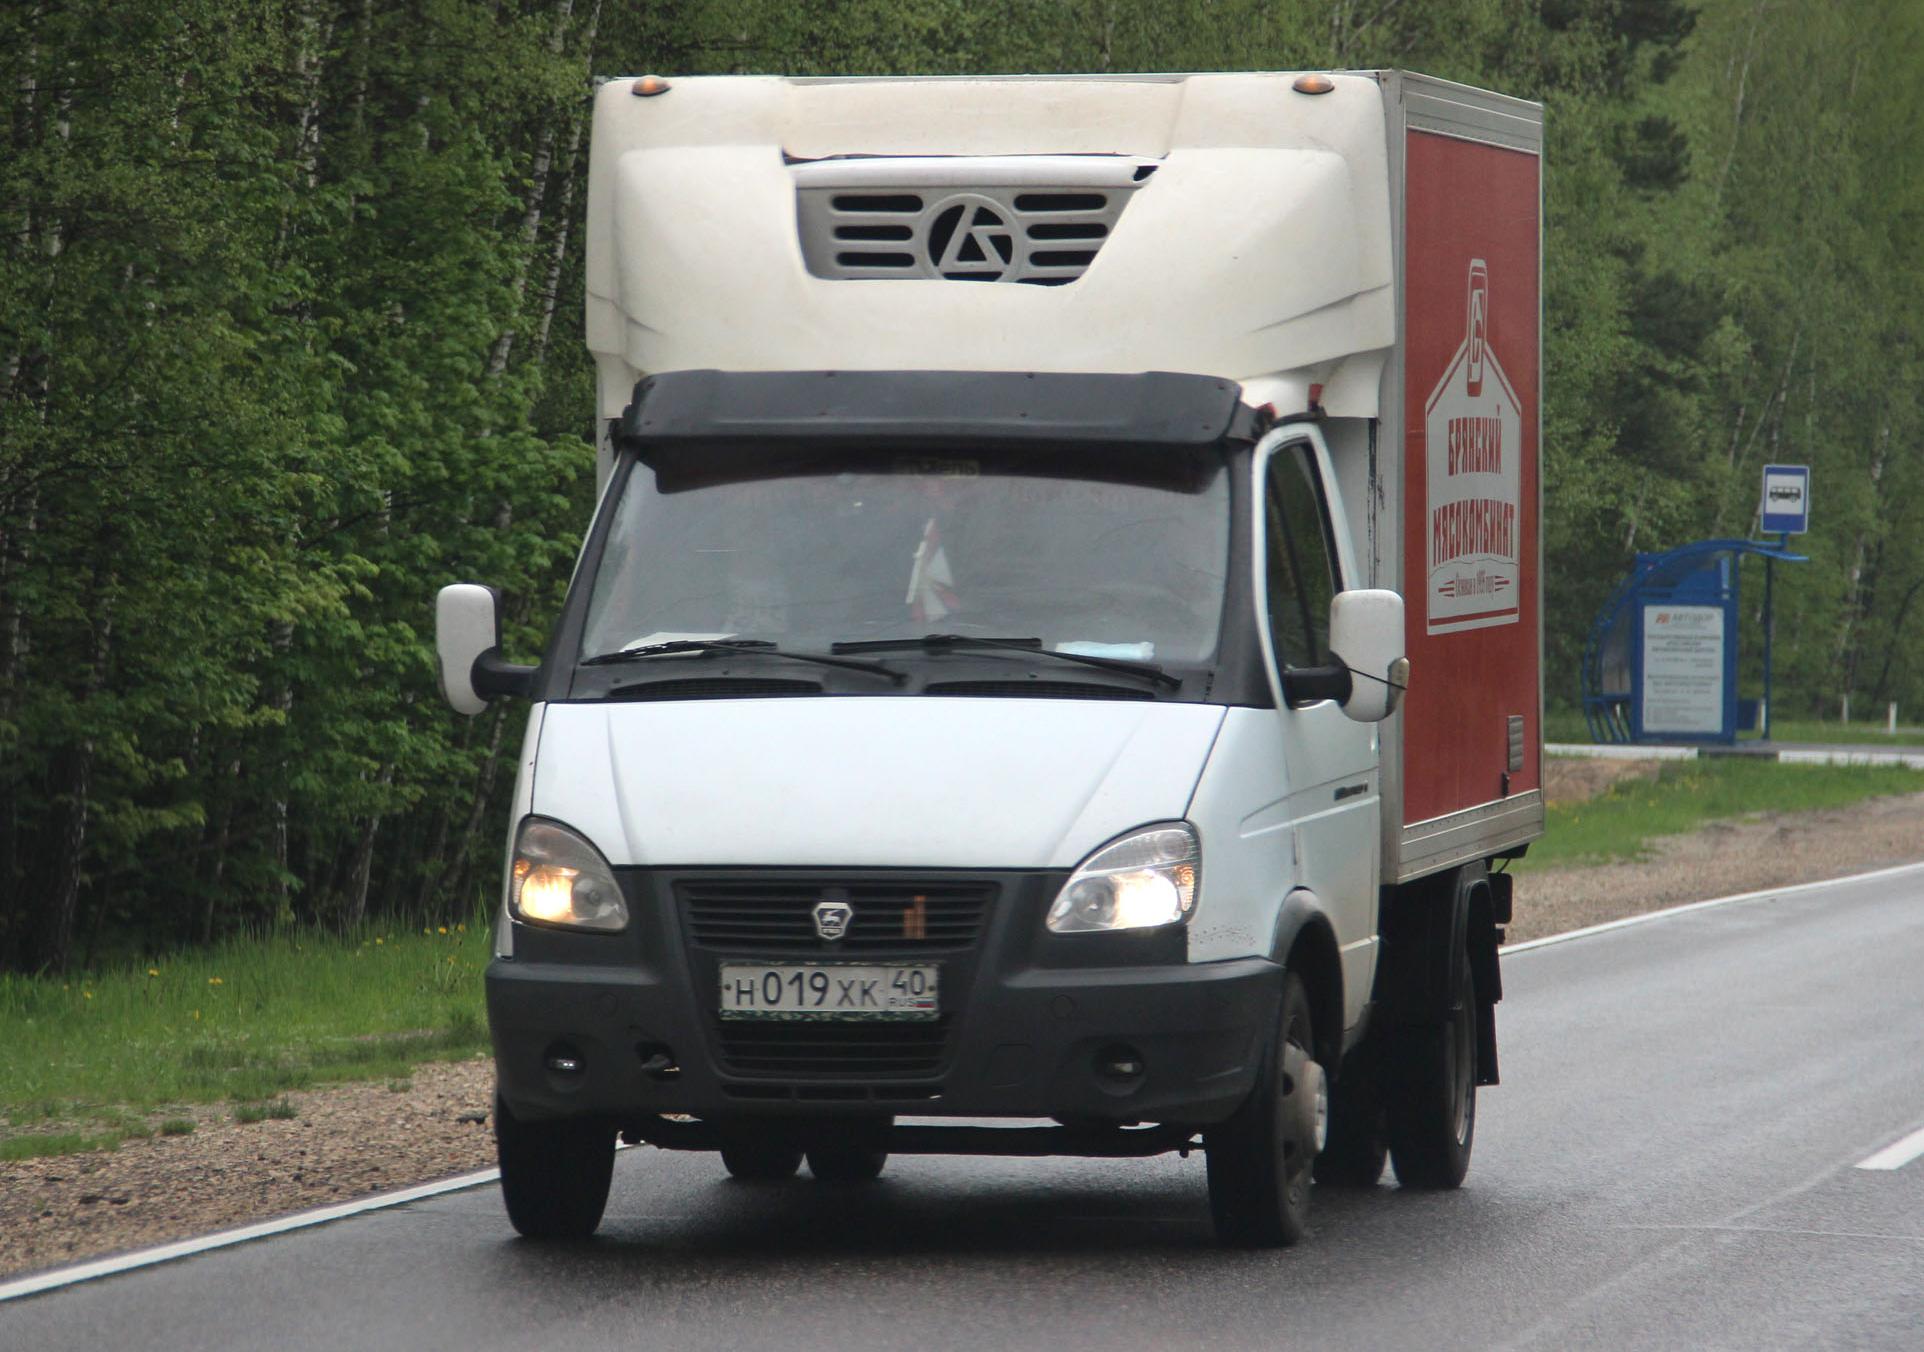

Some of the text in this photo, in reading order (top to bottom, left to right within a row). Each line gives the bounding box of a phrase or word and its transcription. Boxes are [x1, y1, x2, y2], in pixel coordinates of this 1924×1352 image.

[1448, 404, 1502, 477] БРЯНСКИЙ
[1433, 499, 1515, 567] МЯСОКОМБИНАТ
[892, 970, 926, 996] 40
